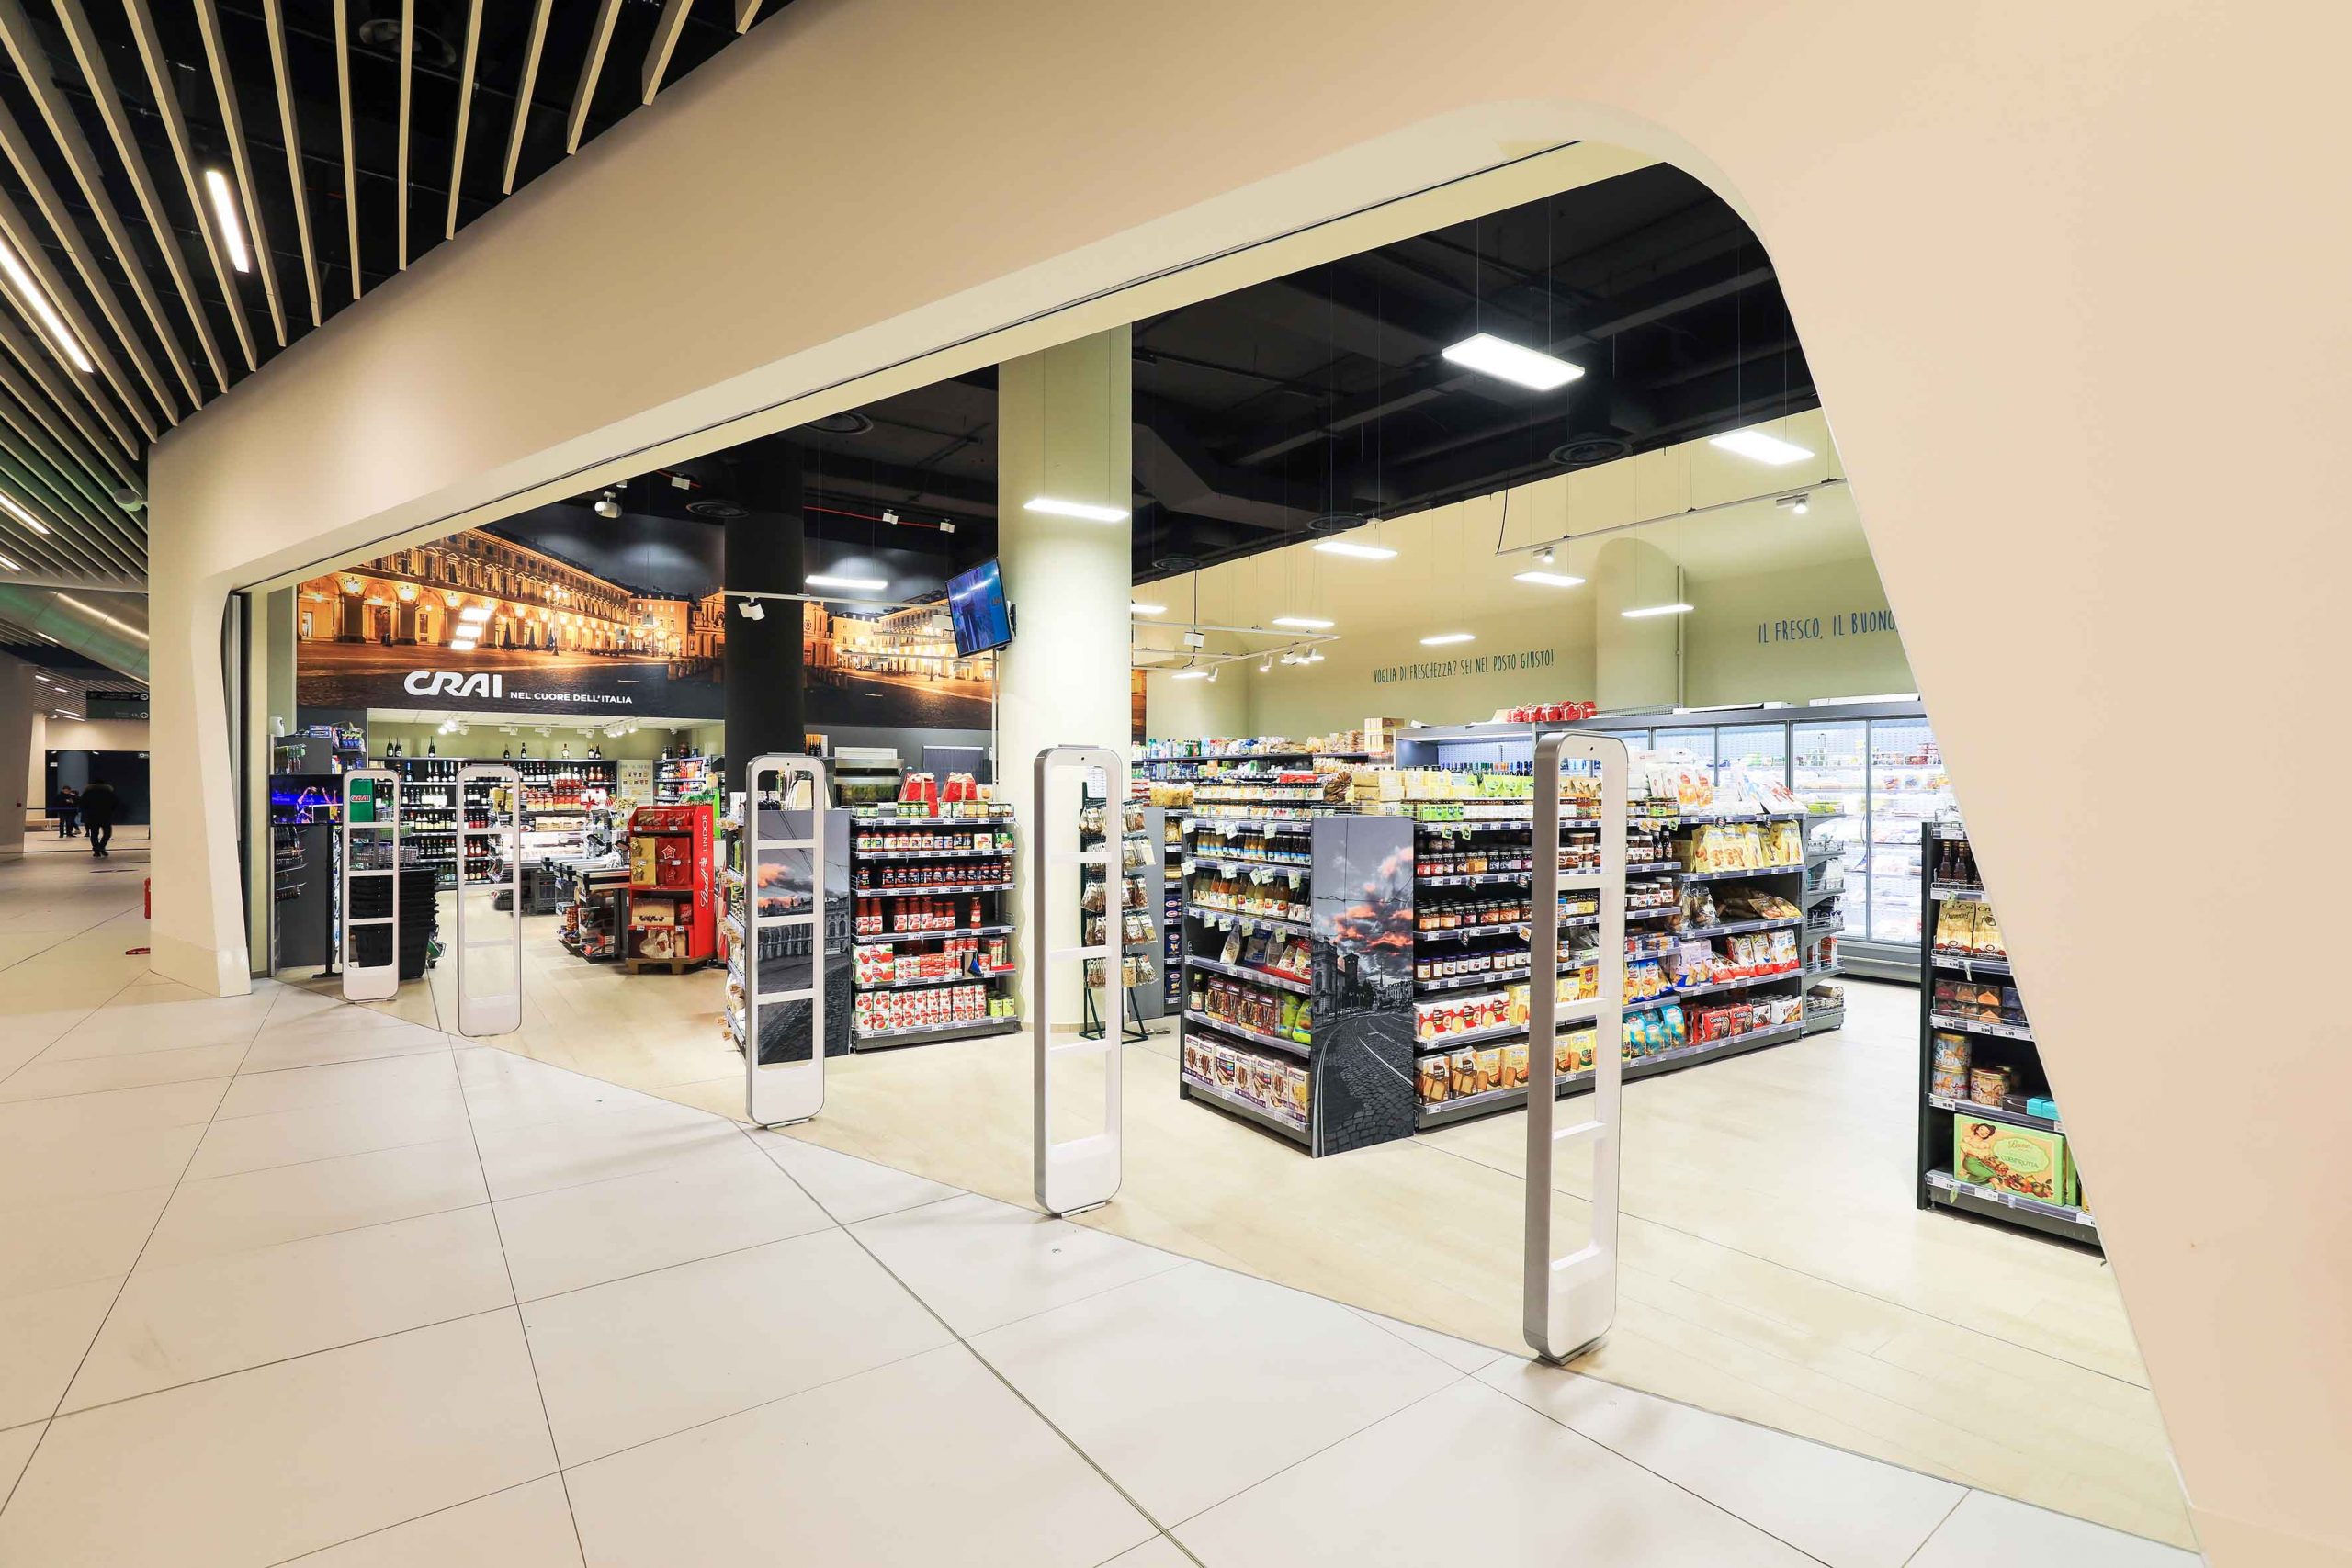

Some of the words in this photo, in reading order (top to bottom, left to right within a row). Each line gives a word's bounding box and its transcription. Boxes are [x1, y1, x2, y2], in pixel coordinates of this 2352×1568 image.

[1758, 622, 1769, 644] IL
[1775, 617, 1824, 641] FRESCO,
[1833, 614, 1845, 637] IL
[1374, 666, 1396, 683] VOGLIA
[1399, 665, 1407, 682] DI
[1409, 660, 1458, 681] FRESCHEZZA?
[1460, 659, 1473, 675] SEI
[1476, 656, 1489, 674] NEL
[1493, 653, 1517, 671] POSTO
[1521, 649, 1555, 670] GIUSTO!
[403, 670, 503, 698] CRAI
[510, 691, 531, 701] NEL
[534, 692, 571, 702] CUORE
